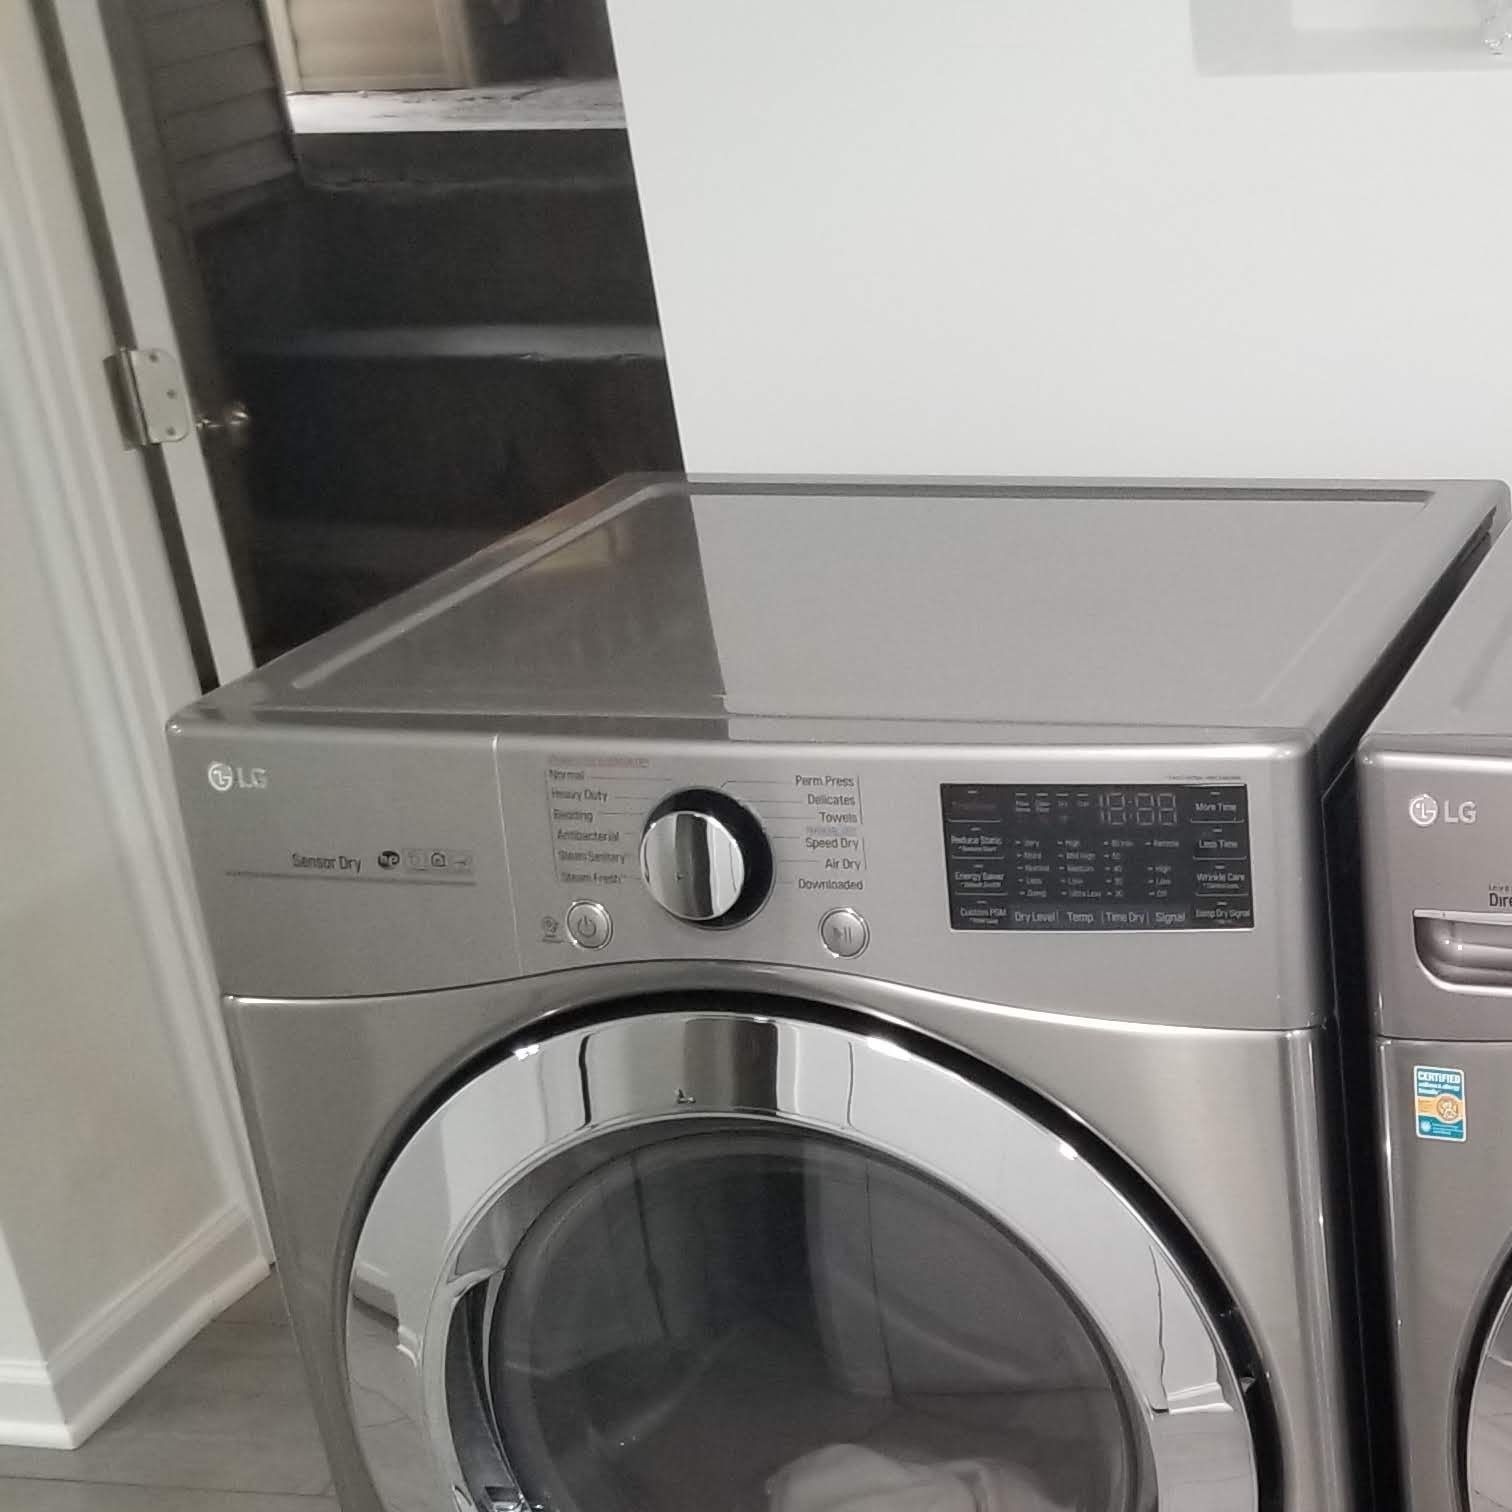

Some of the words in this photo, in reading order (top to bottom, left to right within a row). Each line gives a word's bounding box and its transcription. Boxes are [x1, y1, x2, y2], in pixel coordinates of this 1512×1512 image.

[238, 769, 267, 788] LG
[549, 769, 584, 781] Normal
[825, 776, 854, 787] Press
[552, 789, 582, 802] Heavy
[584, 789, 608, 802] Duty
[808, 794, 856, 806] Delicates
[553, 810, 593, 822] Bedding
[819, 812, 857, 823] Towels
[1443, 801, 1477, 824] LG
[557, 829, 619, 842] Antibacterial
[805, 838, 837, 850] Speed
[840, 838, 858, 850] Dry
[292, 853, 336, 868] Sensor
[339, 854, 362, 872] Dry
[825, 859, 842, 869] Air
[843, 859, 861, 871] Dry
[798, 878, 863, 891] Downloaded
[1015, 912, 1031, 923] Dry
[1031, 912, 1056, 921] Level
[1106, 912, 1125, 921] Time
[1128, 912, 1145, 923] Dry
[1155, 912, 1186, 923] Signal
[1418, 1072, 1460, 1083] CERTIFIED
